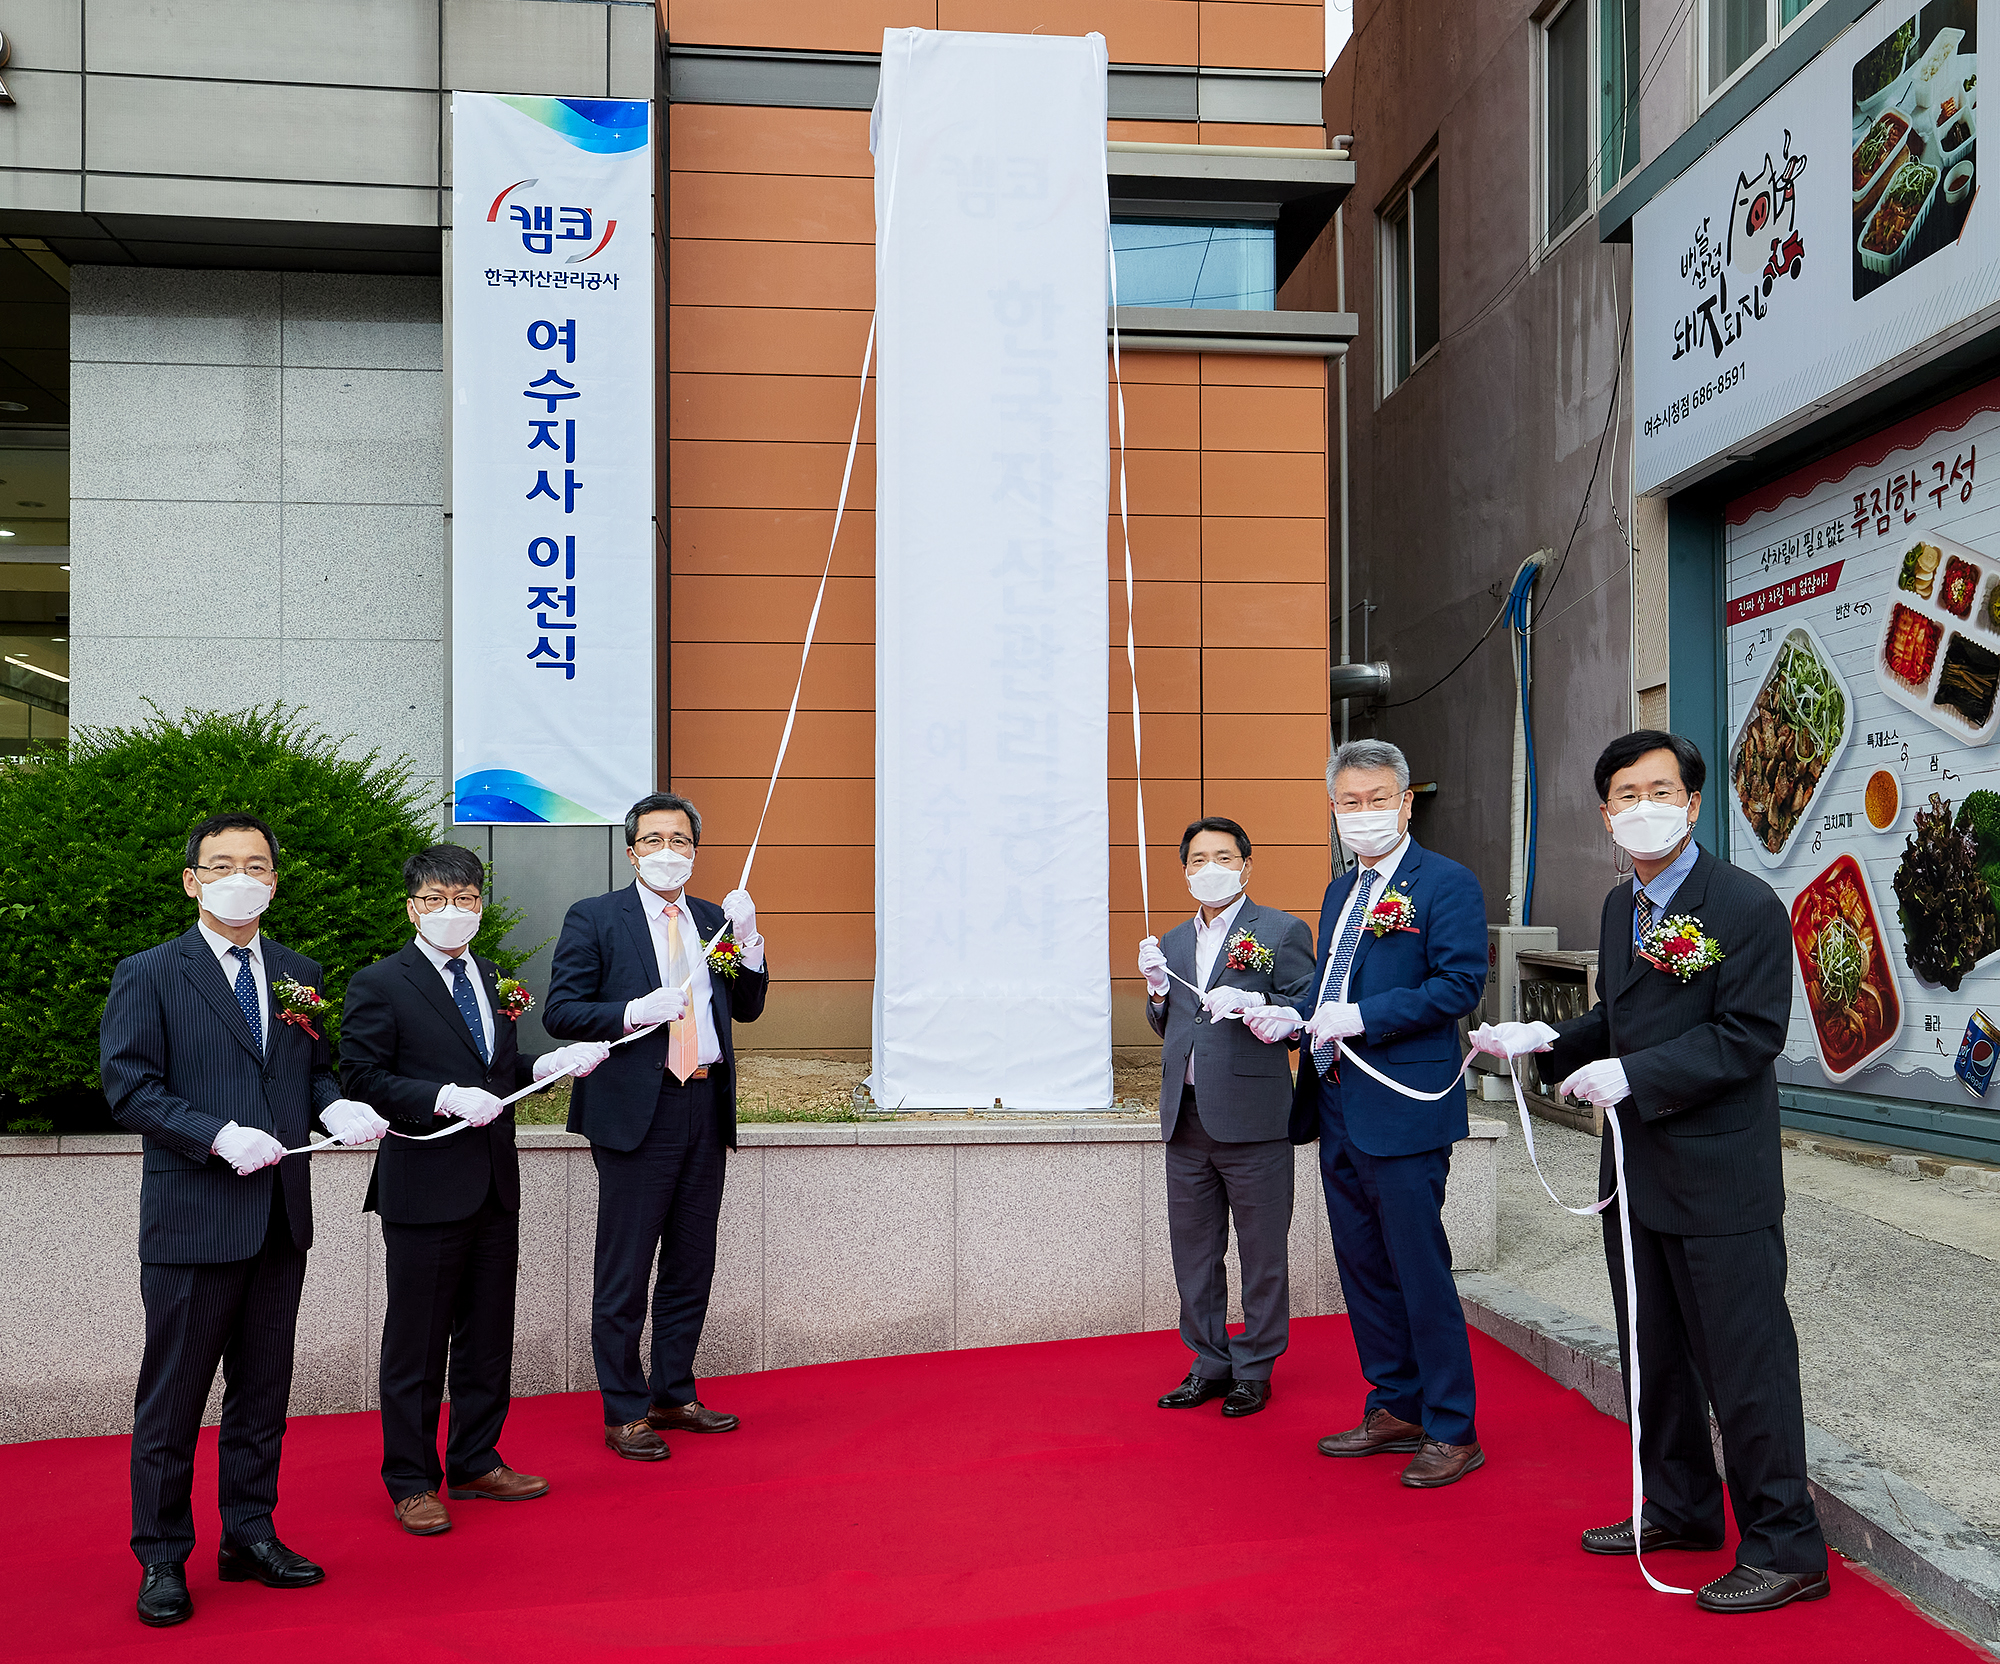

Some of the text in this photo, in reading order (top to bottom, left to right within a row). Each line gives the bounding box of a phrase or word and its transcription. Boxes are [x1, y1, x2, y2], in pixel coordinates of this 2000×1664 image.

[510, 204, 593, 254] 캠코
[484, 268, 620, 290] 한국자산관리공사
[1644, 361, 1745, 438] 여수시청점 686-8591
[523, 318, 584, 681] 여수지사 이전식
[1761, 537, 1800, 572] 상차림이
[1850, 469, 1922, 538] 푸짐한
[1928, 444, 1976, 509] 구성
[1738, 598, 1755, 617] 진짜
[1835, 602, 1851, 620] 반찬
[1866, 729, 1899, 749] 특제소스
[1823, 812, 1853, 830] 김치찌개
[1488, 970, 1497, 983] LG
[1924, 1014, 1941, 1032] 콜라
